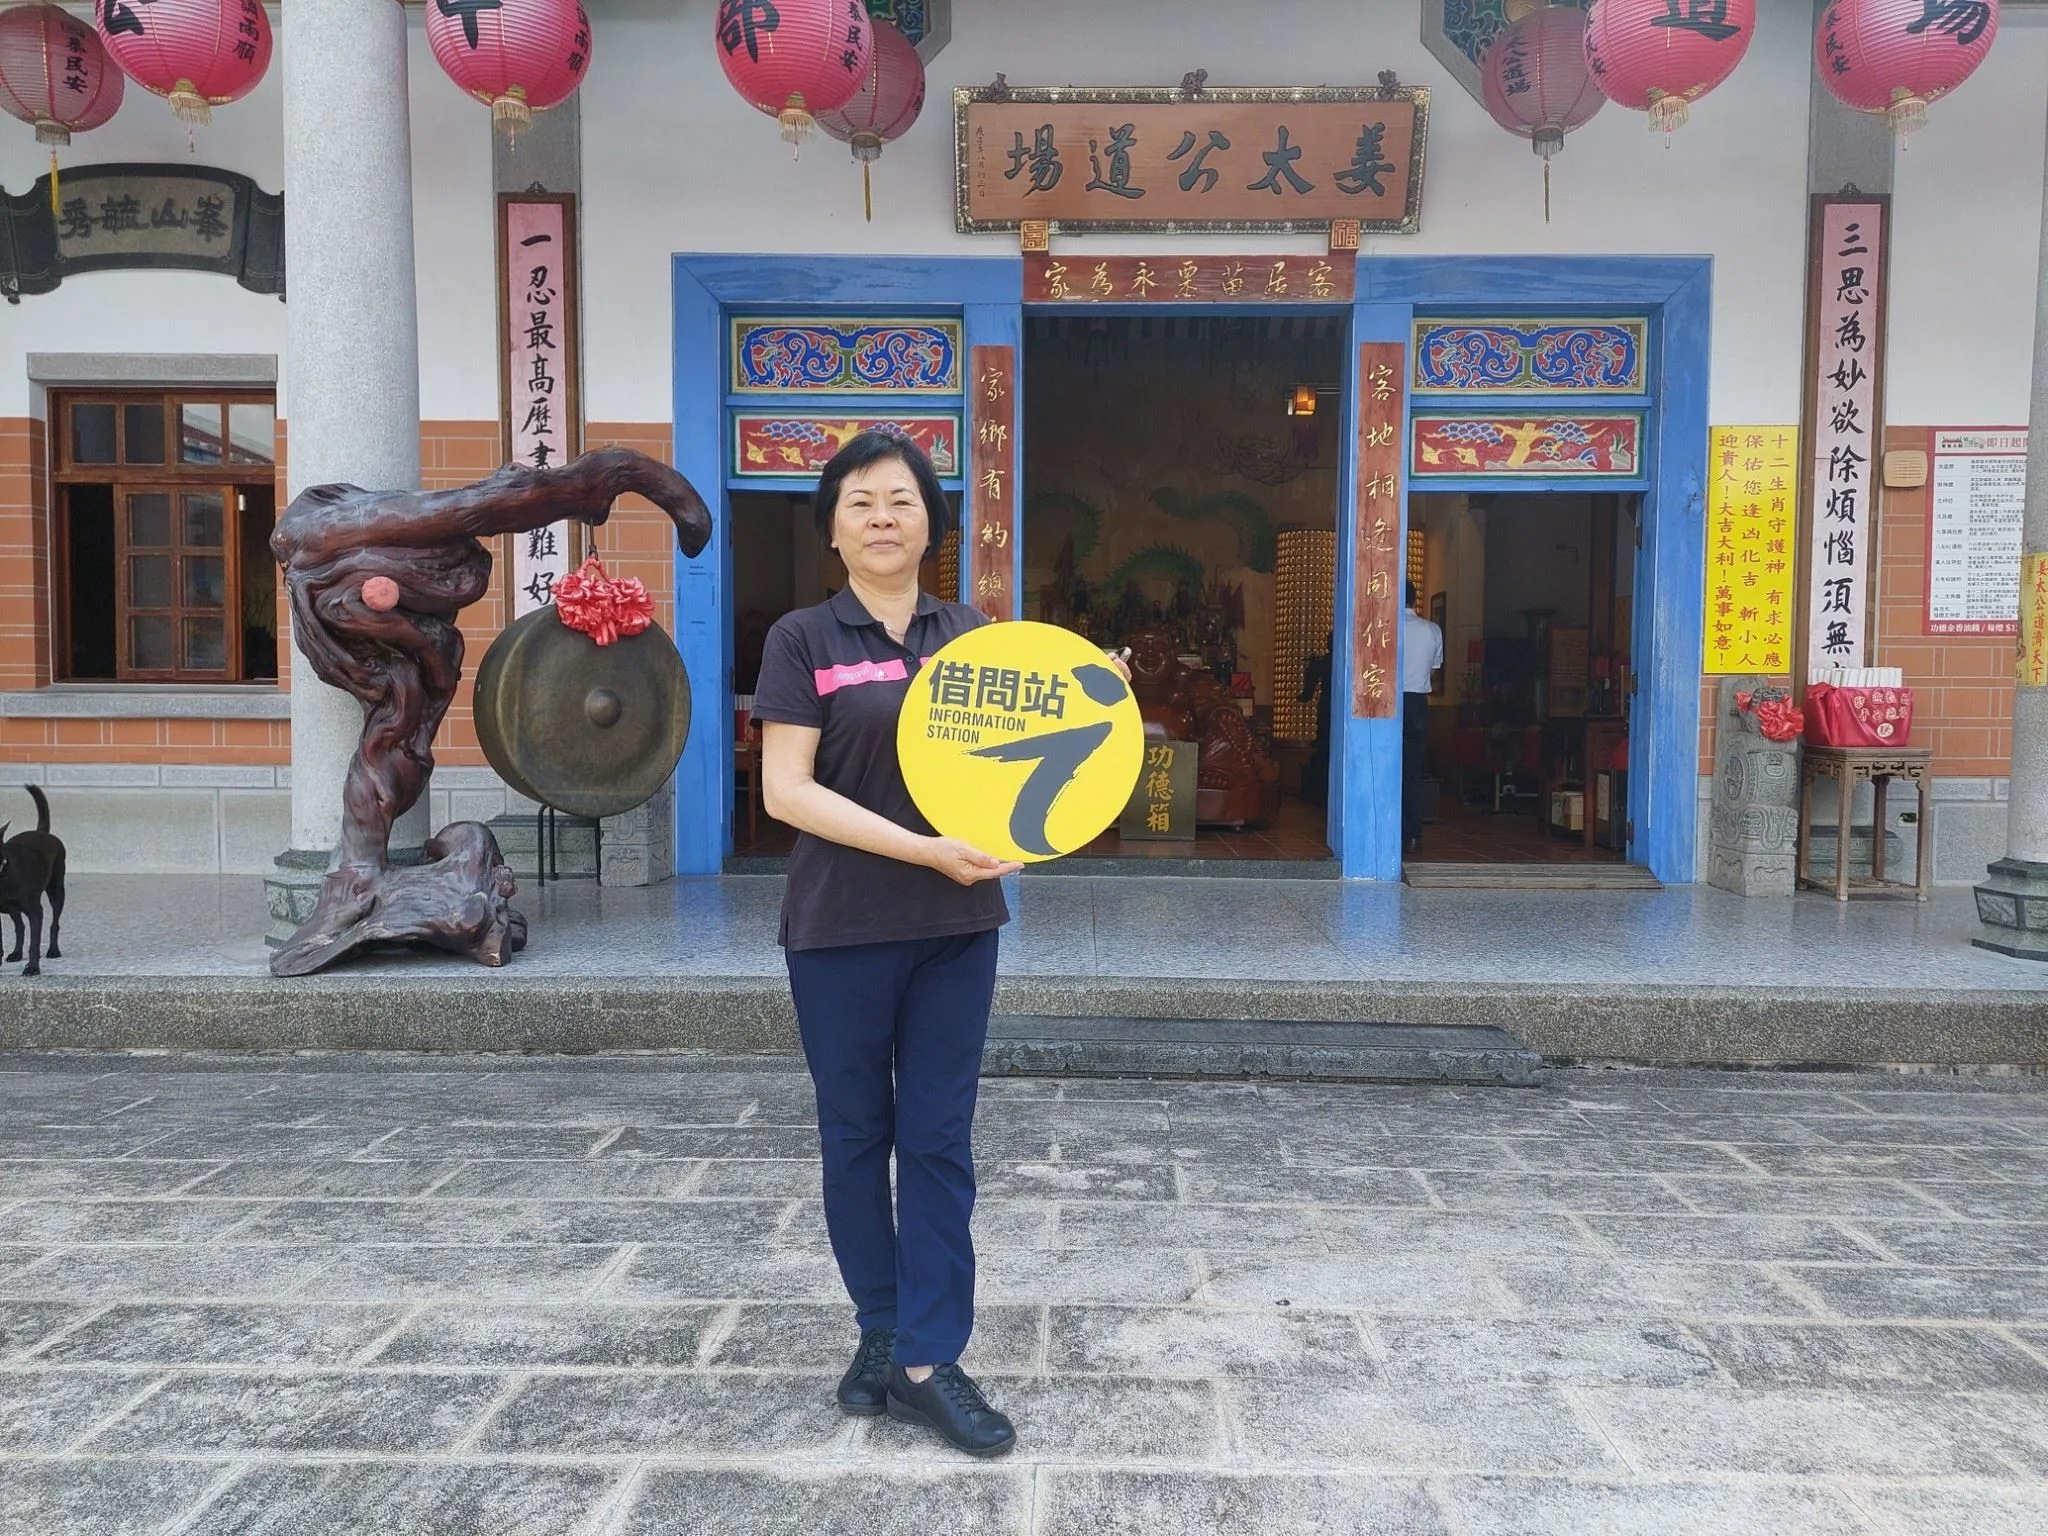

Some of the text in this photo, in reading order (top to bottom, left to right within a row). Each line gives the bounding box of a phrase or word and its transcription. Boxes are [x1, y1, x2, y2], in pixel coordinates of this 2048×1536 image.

[1004, 121, 1396, 199] 姜太公道場
[1820, 222, 1869, 670] 三思為妙欲除煩惱須無
[928, 707, 1027, 732] INFORMATION
[929, 660, 1068, 719] 借問站
[927, 724, 980, 743] STATION
[1146, 744, 1174, 832] 功德箱
